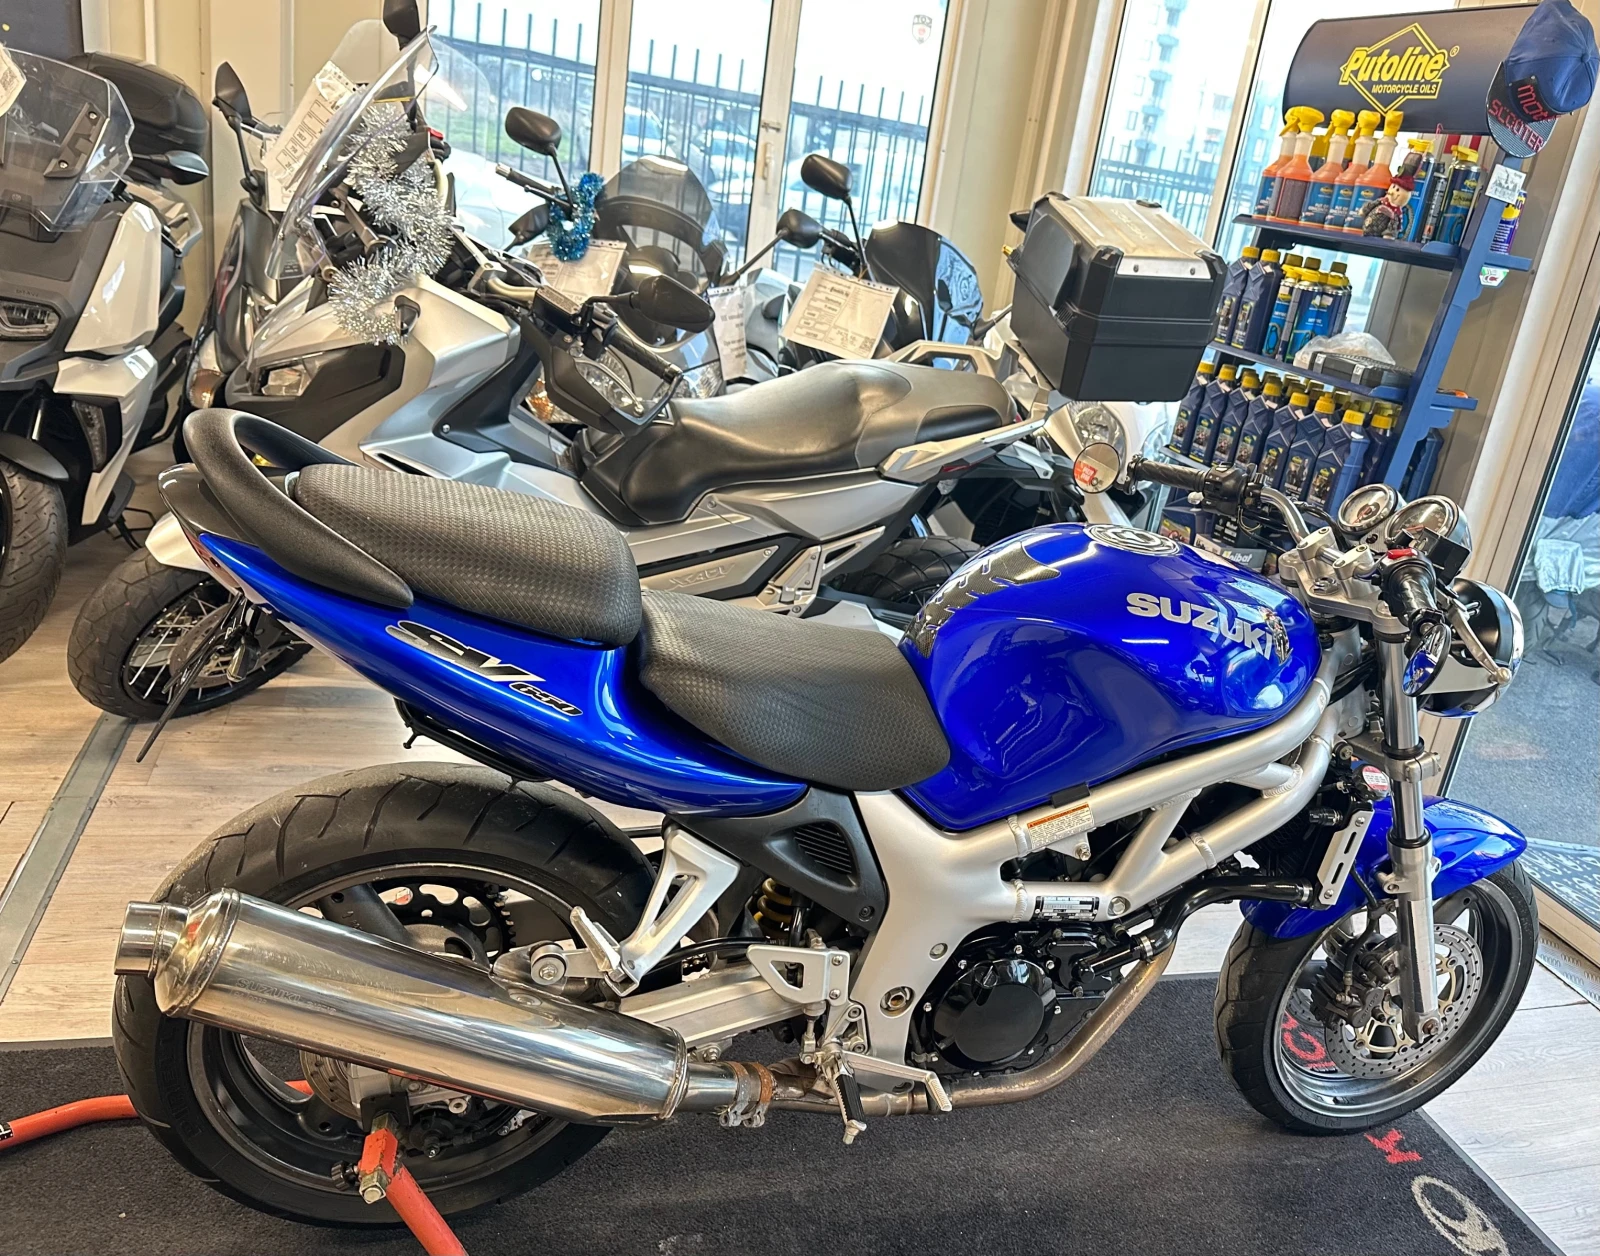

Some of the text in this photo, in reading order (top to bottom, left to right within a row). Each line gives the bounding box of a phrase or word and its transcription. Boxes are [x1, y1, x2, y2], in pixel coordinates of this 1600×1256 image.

[1343, 47, 1445, 81] Putoline
[1371, 84, 1437, 94] MOTORCYCLE OILS
[1126, 592, 1272, 660] SUZUKI
[509, 682, 583, 716] 650
[236, 977, 301, 1002] SUZUKI
